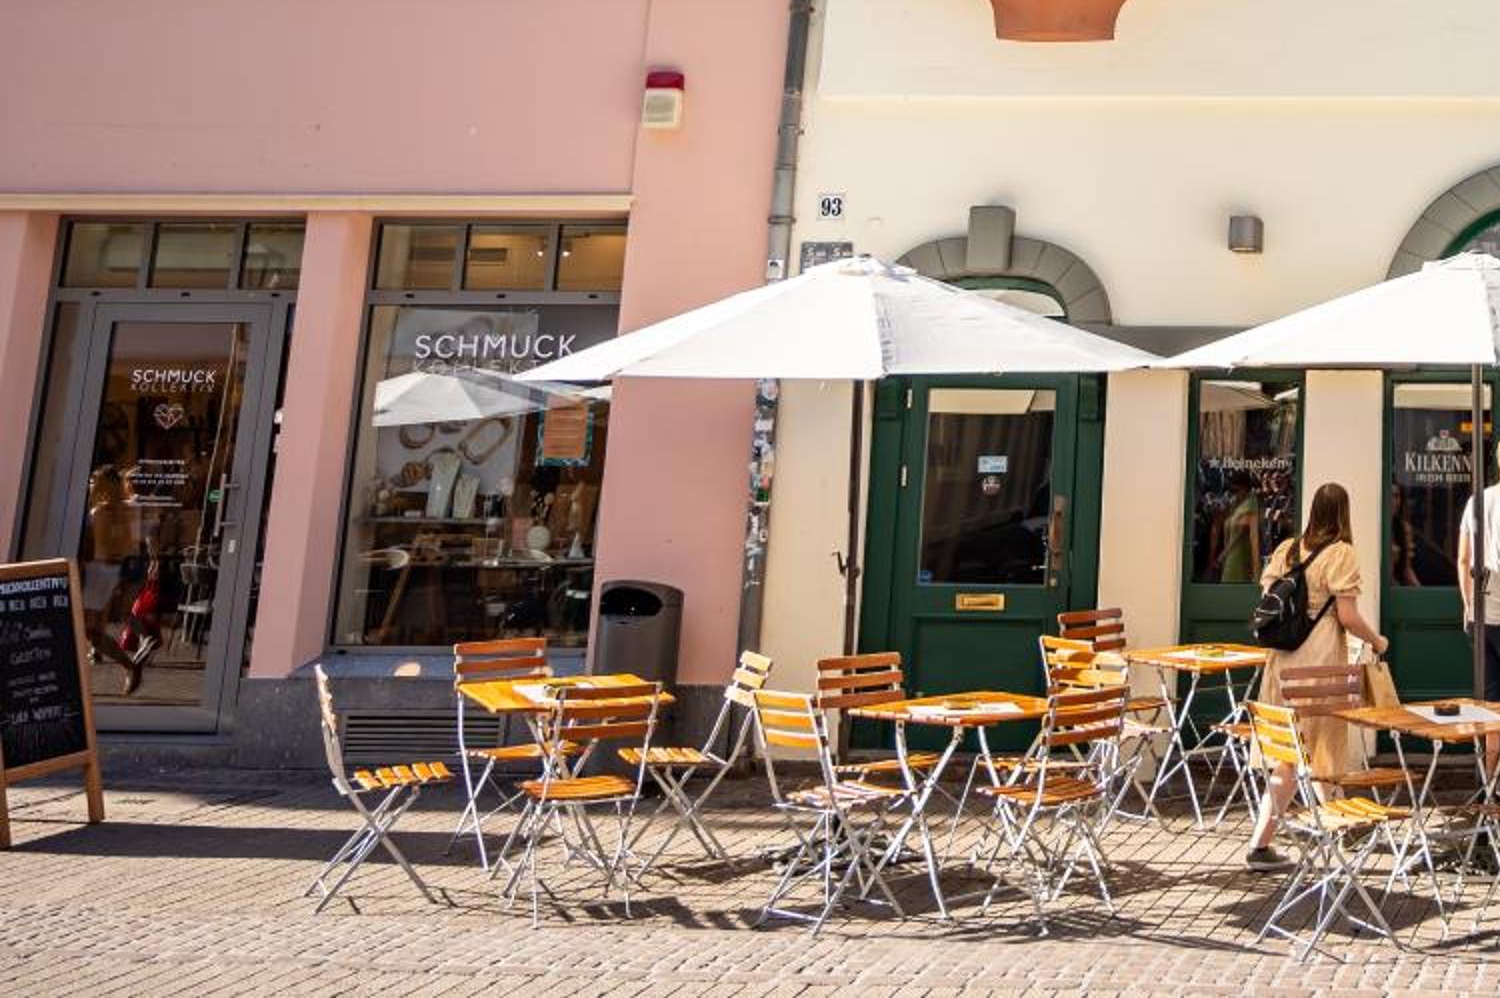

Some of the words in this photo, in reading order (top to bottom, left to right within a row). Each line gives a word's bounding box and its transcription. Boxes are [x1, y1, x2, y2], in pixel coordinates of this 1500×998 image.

[821, 197, 842, 216] 93
[415, 333, 577, 359] SCHMUCK
[132, 369, 217, 383] SCHMUCK
[1405, 451, 1473, 472] KILKENN
